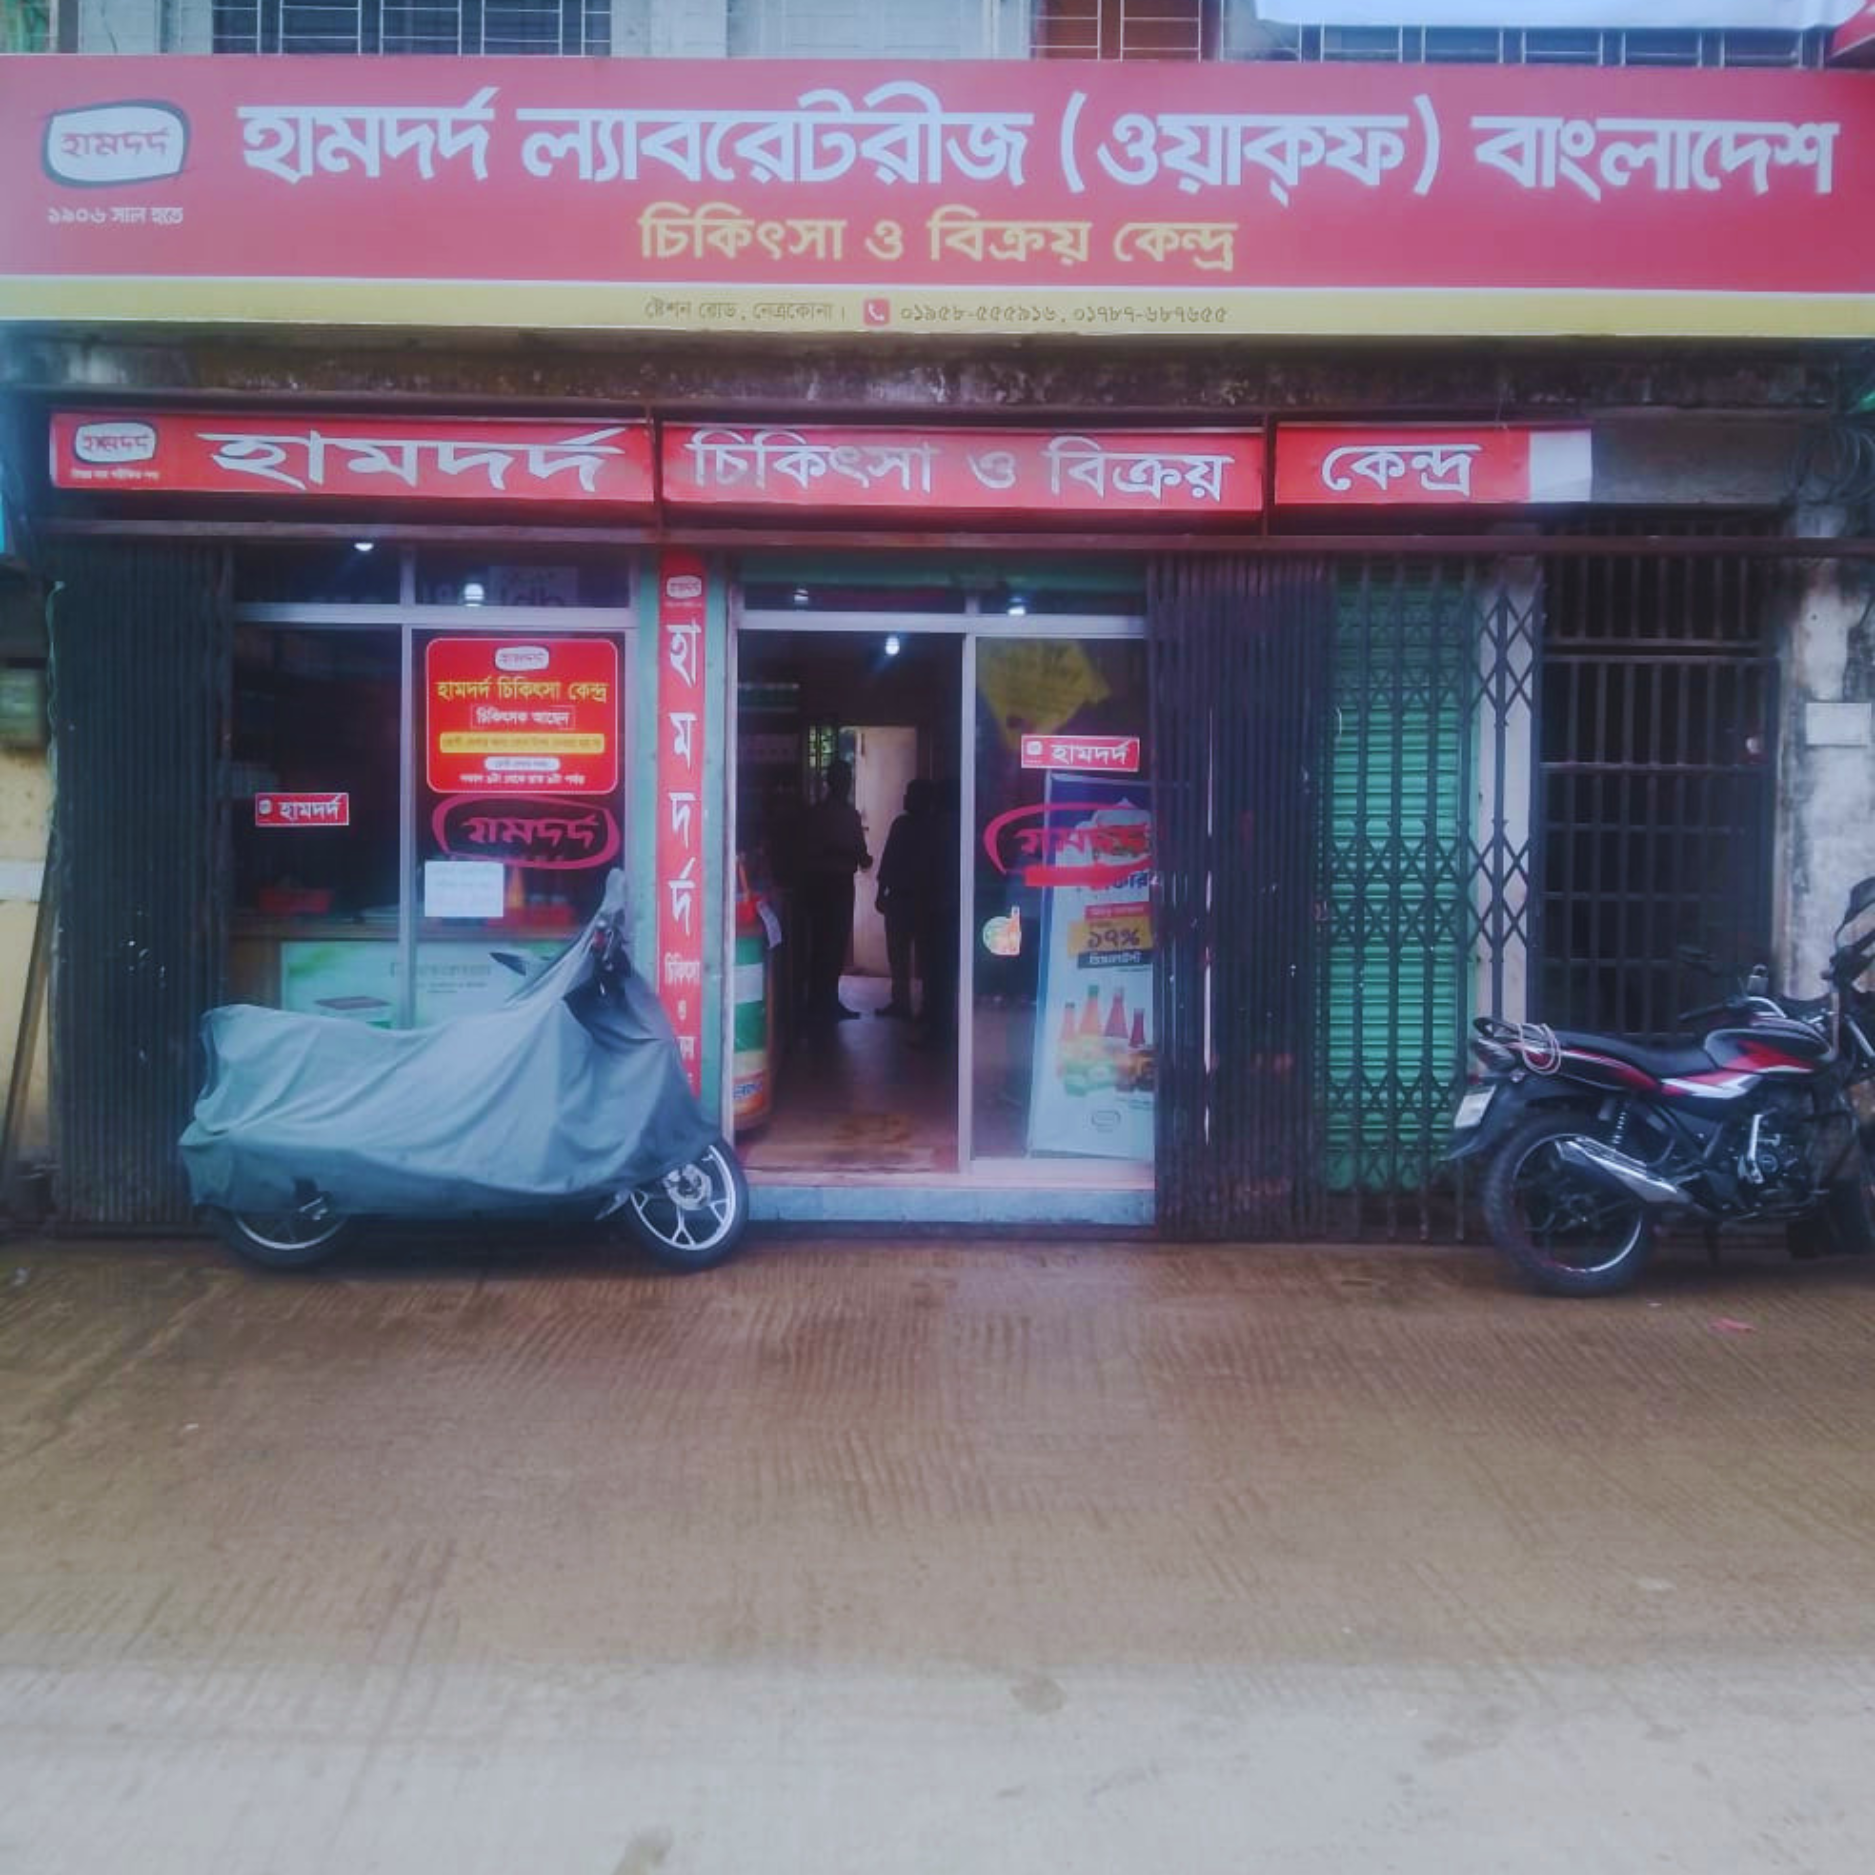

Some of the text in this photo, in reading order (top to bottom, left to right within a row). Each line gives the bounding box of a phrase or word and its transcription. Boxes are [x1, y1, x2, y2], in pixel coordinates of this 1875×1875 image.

[60, 127, 170, 157] হামদর্দ
[236, 86, 500, 185] হামদর্দ
[517, 80, 1034, 188] ল্যাবরেটরীজ
[1470, 116, 1840, 202] বাংলাদেশ
[47, 206, 107, 224] ১৯০৬
[110, 206, 147, 224] সাল
[638, 201, 1239, 272] চিকিৎসা ও বিক্রয় কেন্দ্র
[195, 427, 1482, 500] হামদর্দ চিকিৎসা ও বিক্রয় কেন্দ্র
[436, 676, 610, 702] হামদর্দ চিকিৎসা কেন্দ্র
[1051, 740, 1130, 765] হামদর্দ
[278, 793, 343, 821] হামদর্দ
